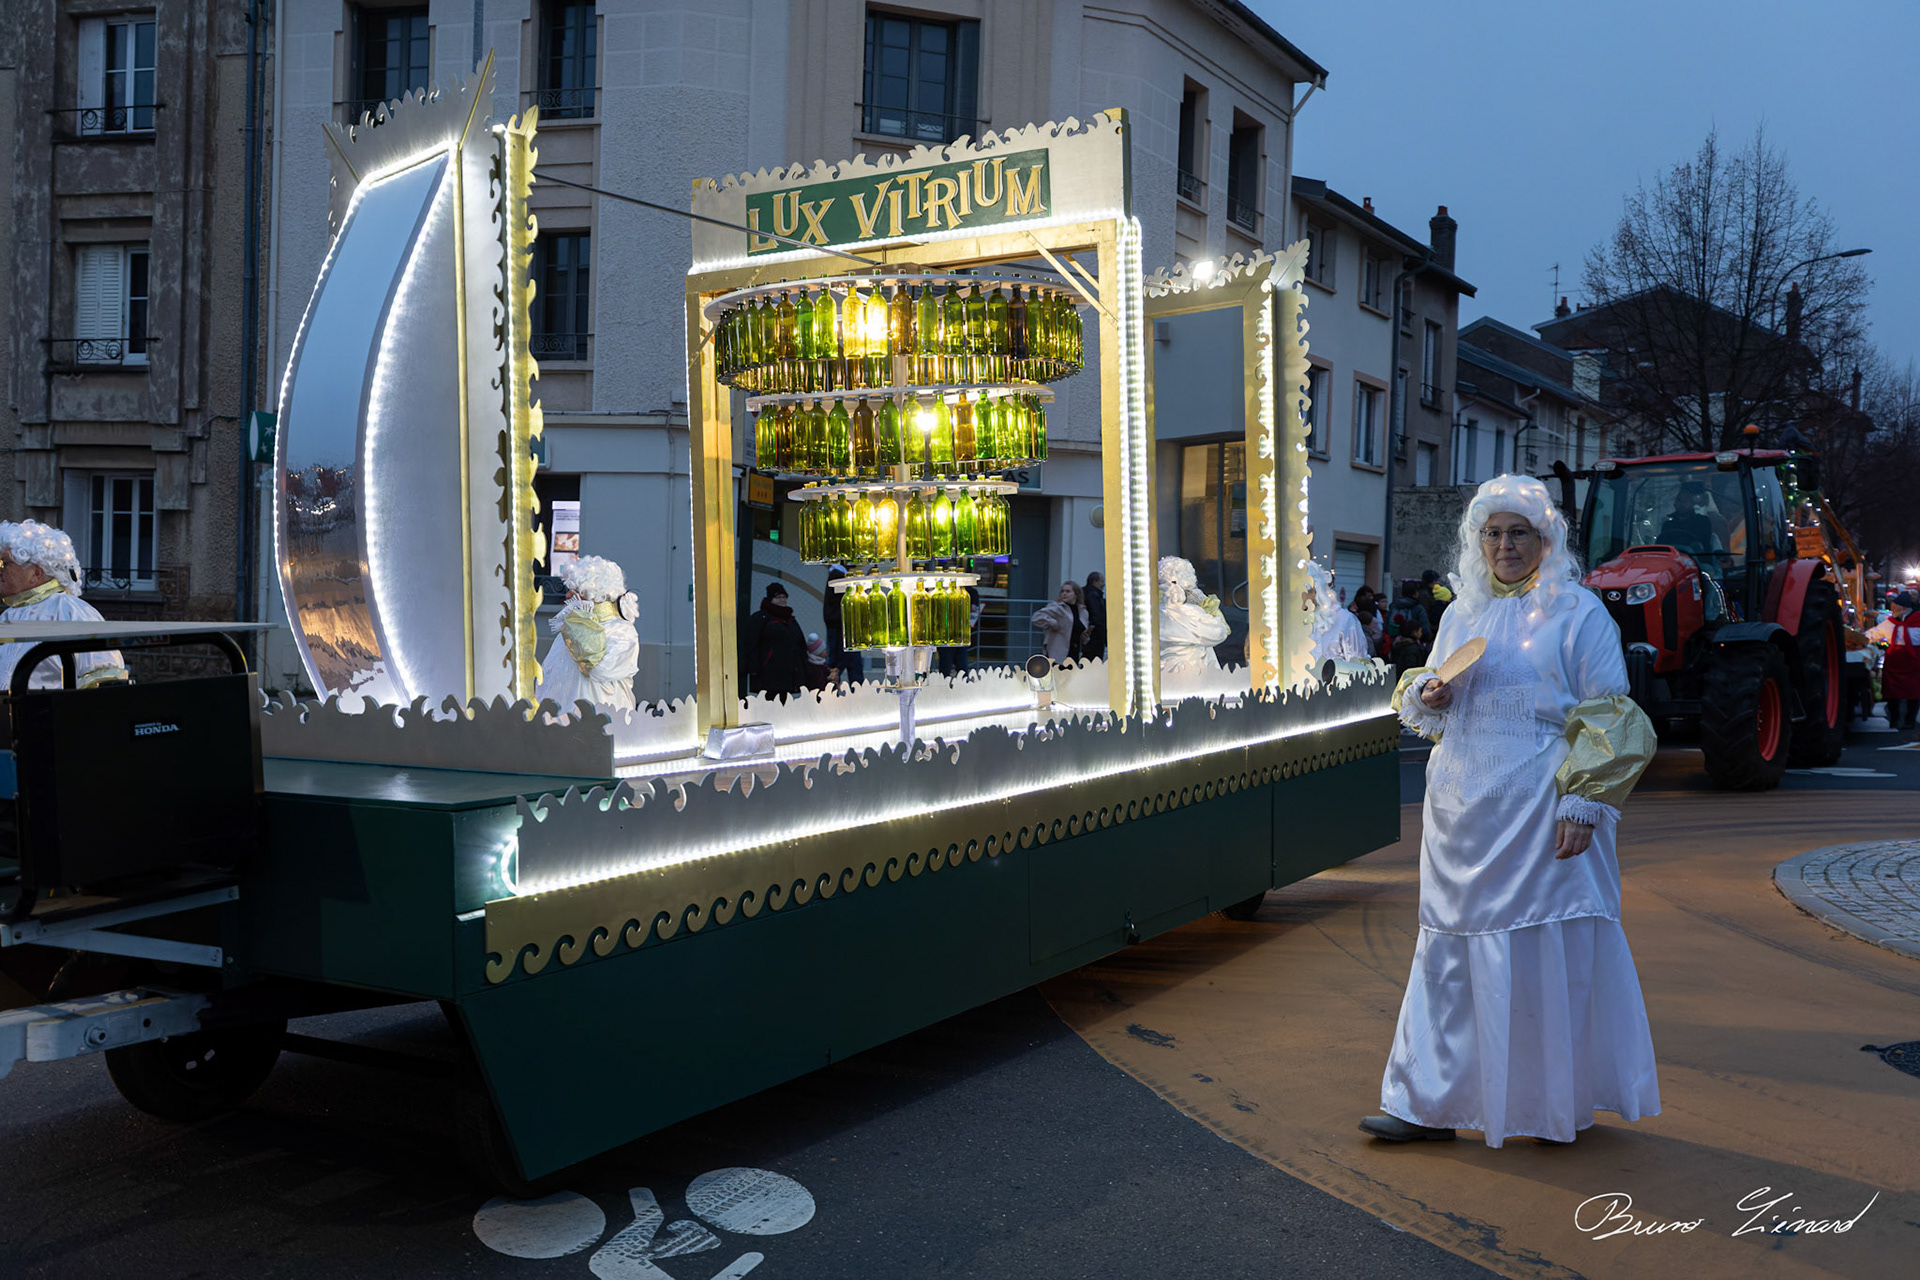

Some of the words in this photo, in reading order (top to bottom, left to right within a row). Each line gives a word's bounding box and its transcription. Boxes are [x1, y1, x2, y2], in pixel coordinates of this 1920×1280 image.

[747, 190, 835, 254] LUX
[849, 157, 1048, 239] VITRIUM
[135, 724, 179, 736] HONDA
